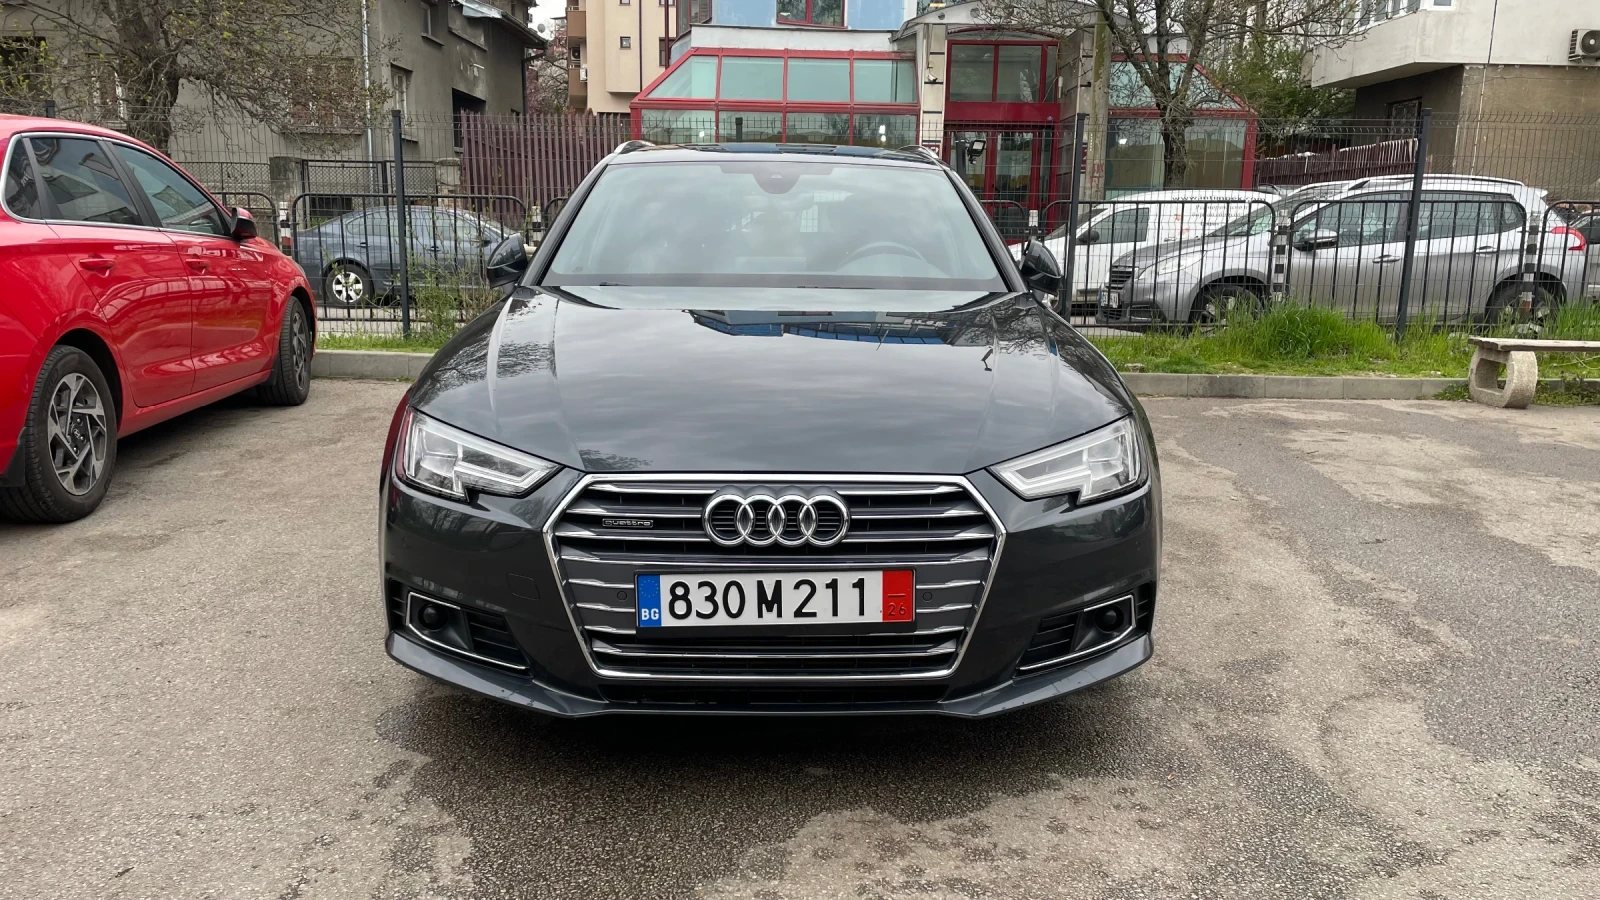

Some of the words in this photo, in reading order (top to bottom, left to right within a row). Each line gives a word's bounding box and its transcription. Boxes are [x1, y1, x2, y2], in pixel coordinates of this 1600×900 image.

[668, 580, 746, 620] 830
[756, 579, 783, 619] M
[793, 577, 865, 618] 211
[641, 608, 660, 621] BG
[887, 602, 907, 616] 26
